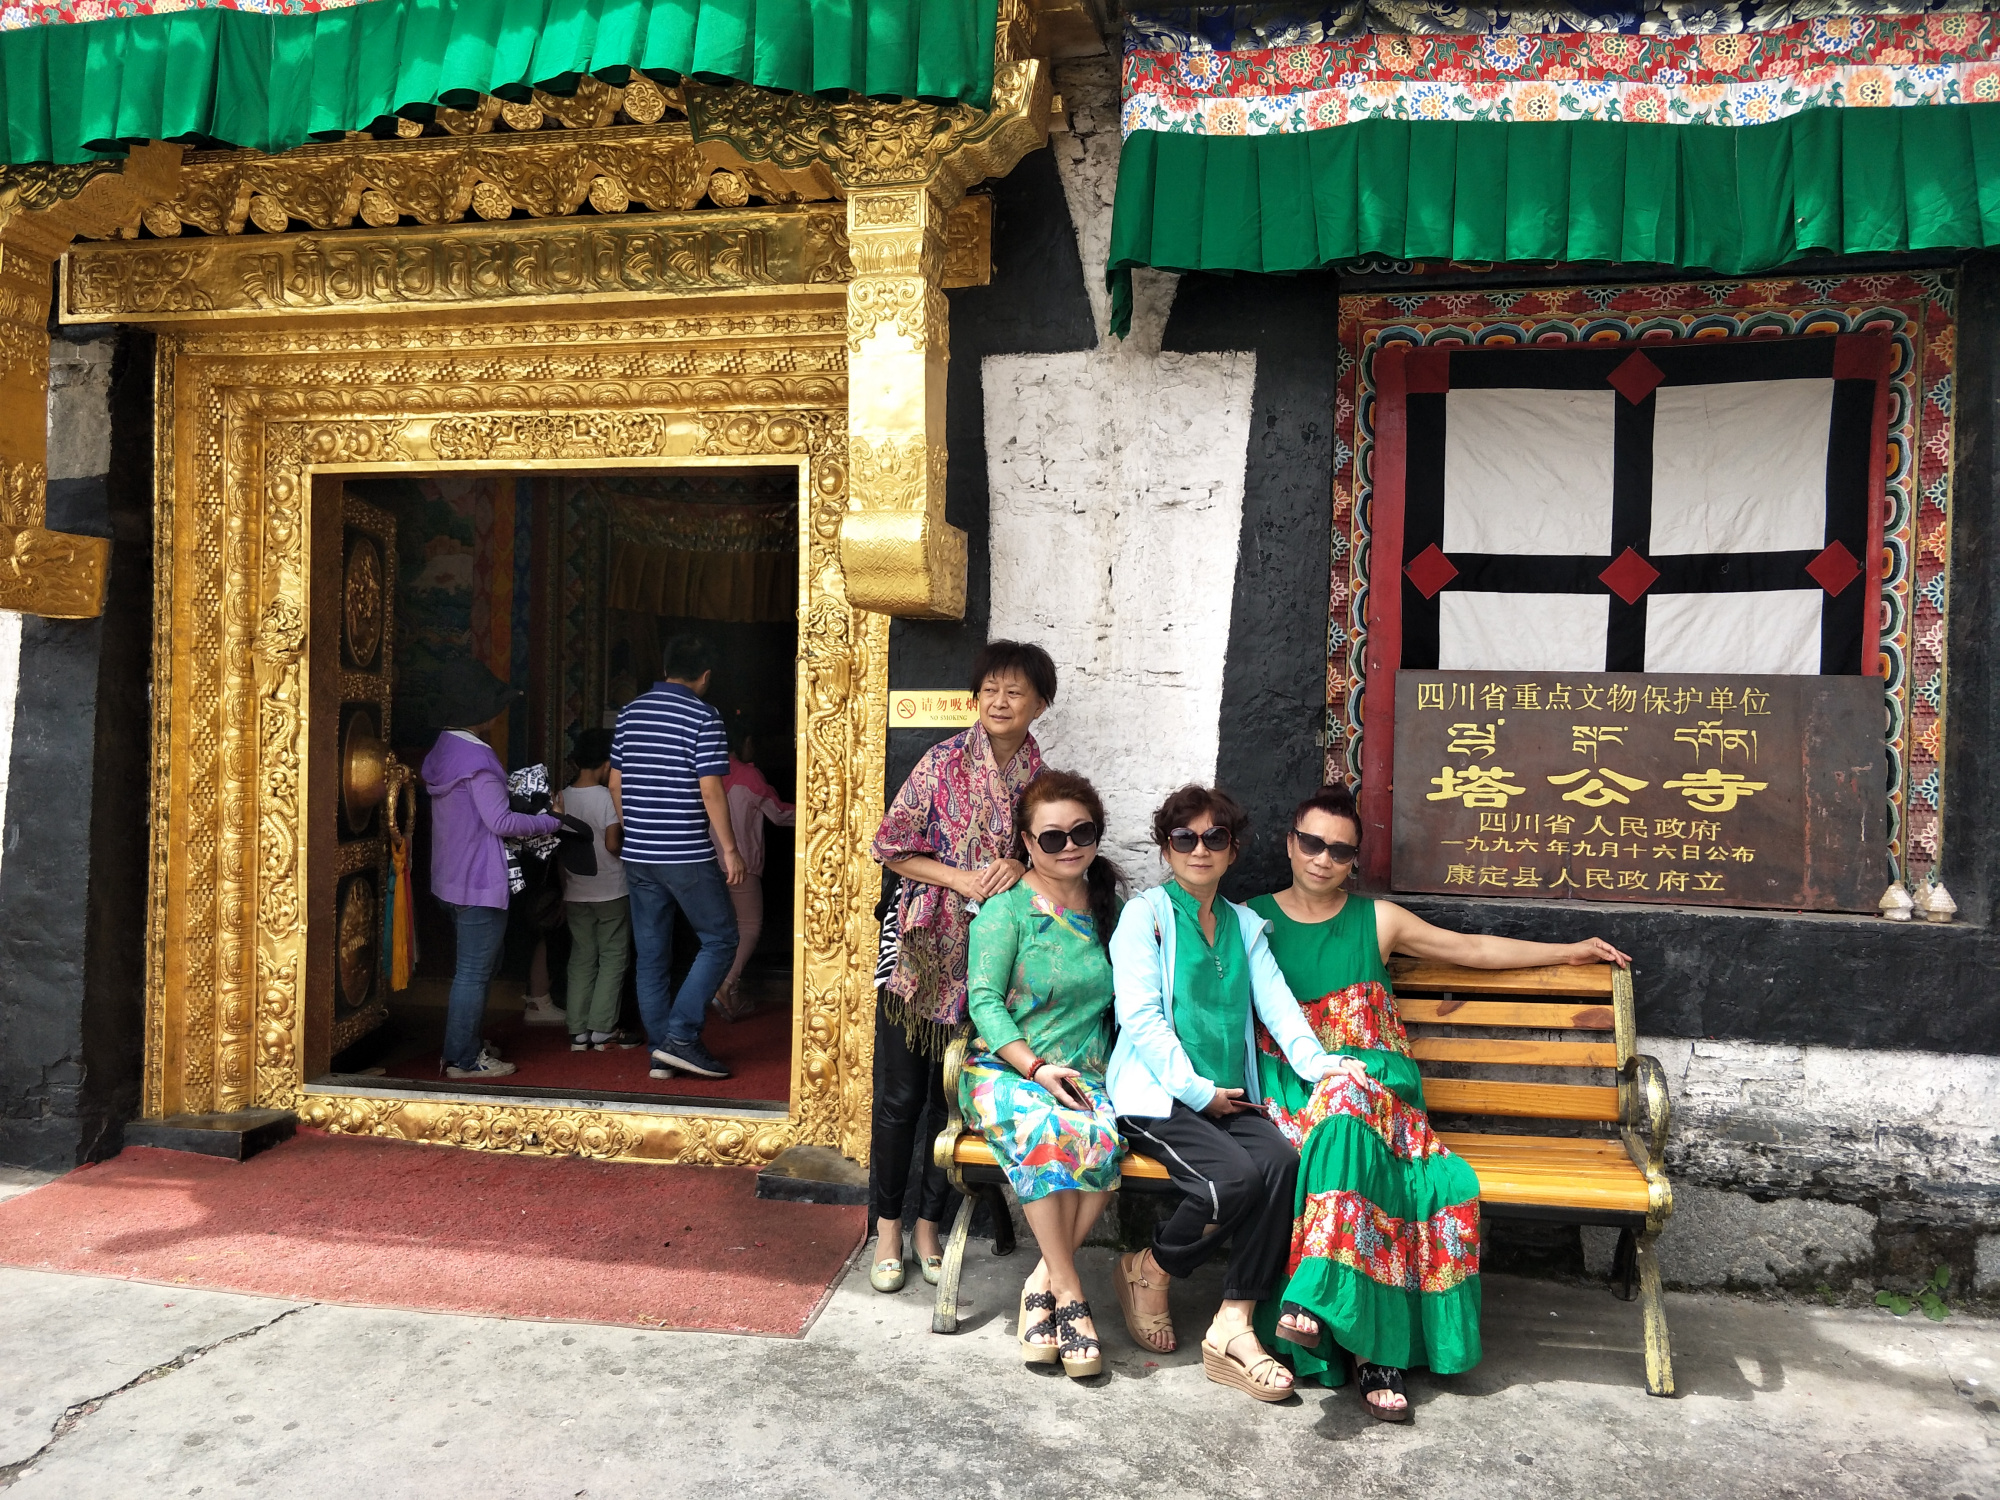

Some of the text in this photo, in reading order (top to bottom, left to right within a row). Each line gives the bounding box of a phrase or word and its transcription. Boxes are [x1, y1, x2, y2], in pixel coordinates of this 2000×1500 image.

[921, 697, 979, 712] 请勿吸烟
[1416, 682, 1771, 717] 四川省重点文物保护单位
[1426, 765, 1769, 813] 塔公寺
[1478, 812, 1722, 842] 四川省人民政府
[1440, 836, 1756, 863] 一九九六年九月十六日公布
[1443, 863, 1726, 893] 康定县人民政府立
